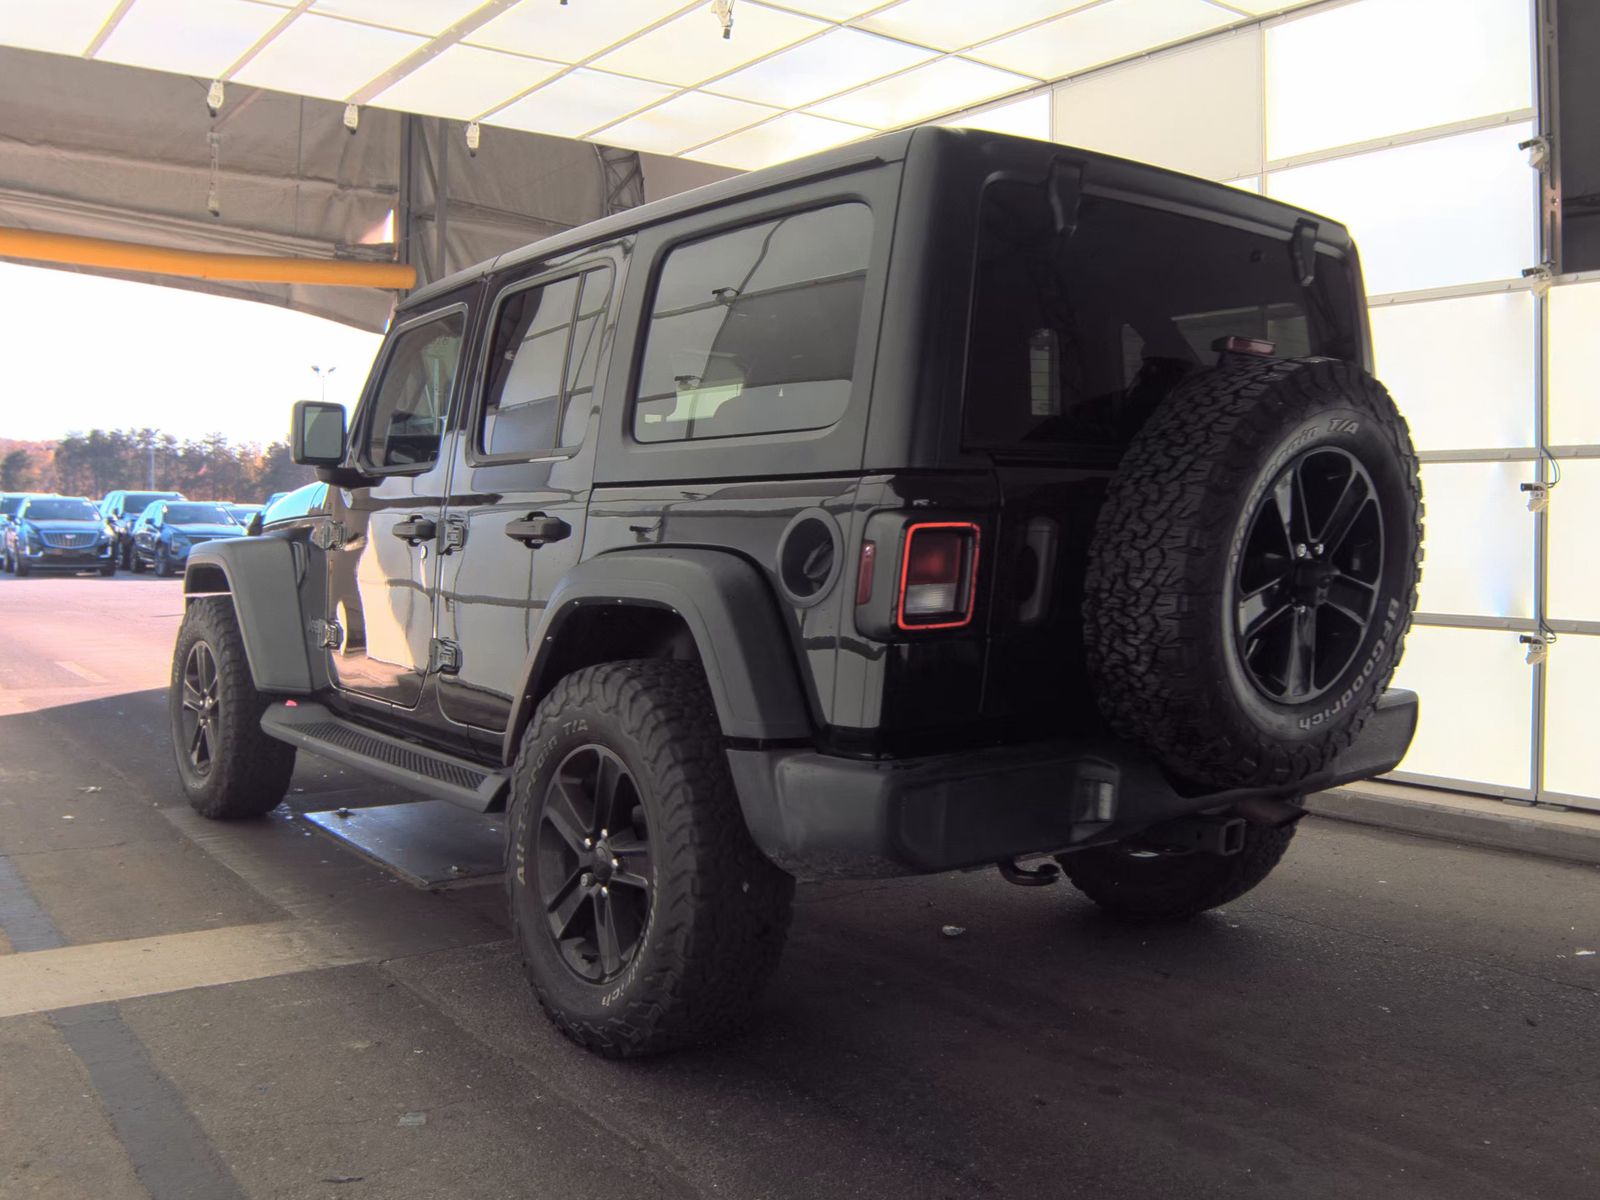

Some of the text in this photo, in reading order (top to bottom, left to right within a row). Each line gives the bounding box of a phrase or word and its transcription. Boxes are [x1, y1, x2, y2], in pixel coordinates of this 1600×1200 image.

[1328, 417, 1361, 435] T/A
[1298, 597, 1400, 731] BFGoodrich
[562, 718, 590, 736] T/A
